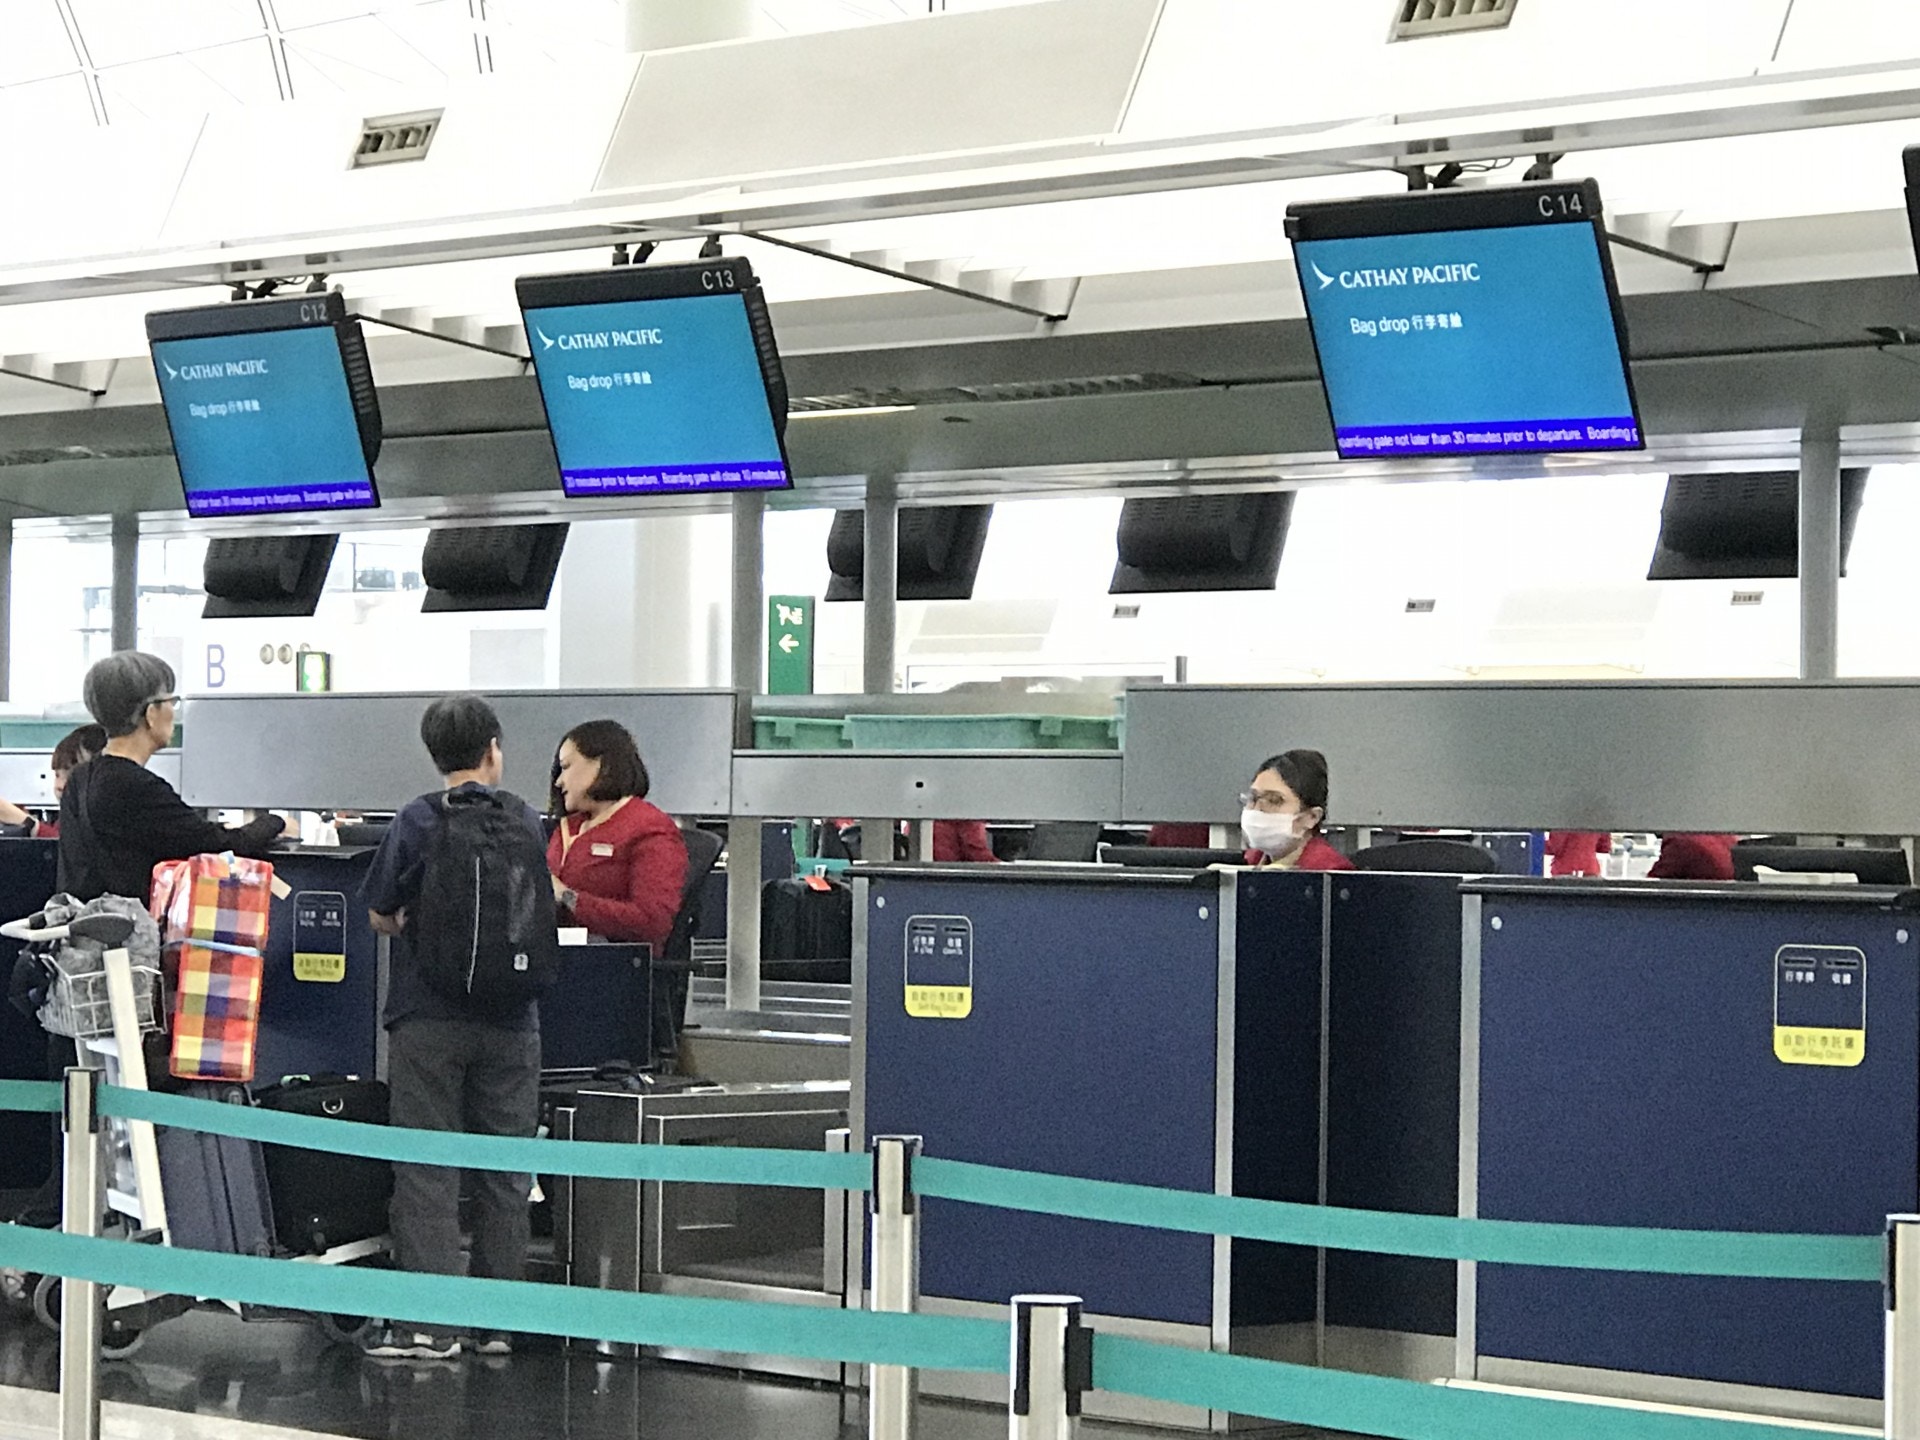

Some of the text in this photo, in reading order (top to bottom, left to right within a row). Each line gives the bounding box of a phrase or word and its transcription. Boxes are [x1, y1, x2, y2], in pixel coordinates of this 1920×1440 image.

[1340, 263, 1480, 289] CATHAY PACIFIC
[1350, 317, 1377, 336] Bag
[1379, 315, 1409, 335] drop
[558, 328, 662, 350] CATHAY PACIFIC
[180, 359, 268, 380] CATHAY PACIFIC
[568, 374, 588, 391] Bag
[589, 373, 612, 389] drop
[1453, 431, 1465, 444] 30
[1525, 430, 1535, 442] to
[1587, 426, 1631, 442] Boarding
[207, 644, 225, 688] B
